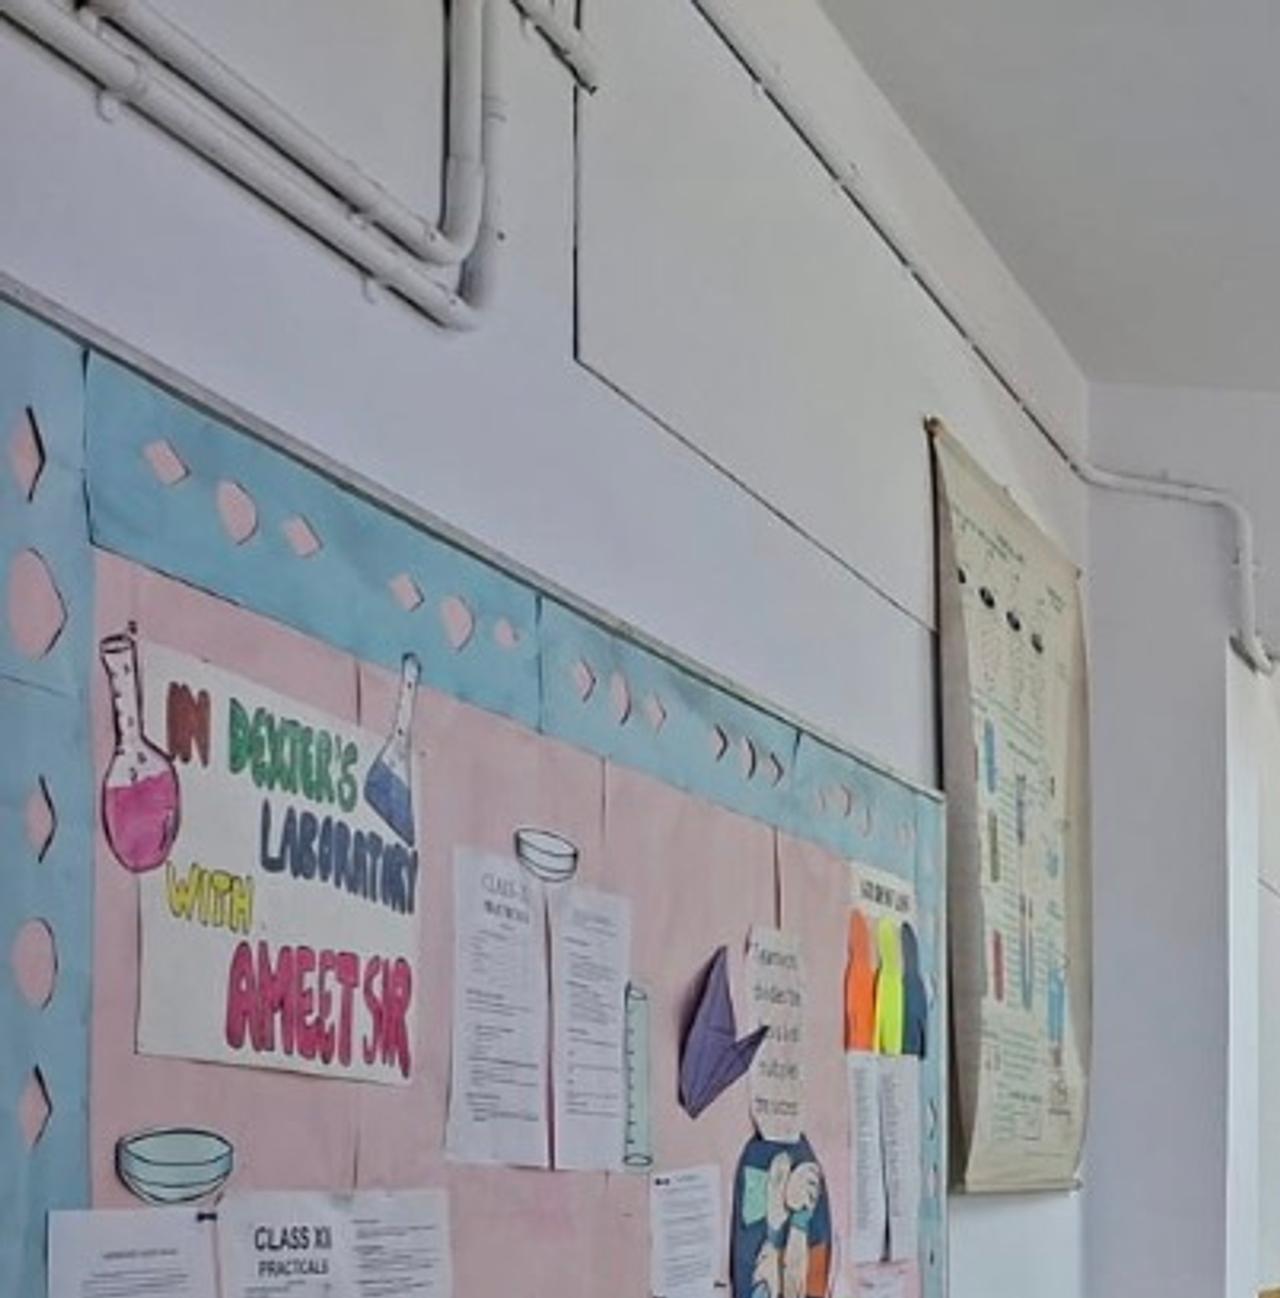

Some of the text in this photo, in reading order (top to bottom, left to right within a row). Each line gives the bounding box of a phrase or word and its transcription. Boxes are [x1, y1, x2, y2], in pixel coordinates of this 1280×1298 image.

[166, 681, 358, 813] IN DEXTER'S
[166, 860, 253, 935] WITH
[226, 939, 359, 1067] AMEET
[363, 955, 412, 1078] SIR
[254, 1226, 310, 1251] CLASS
